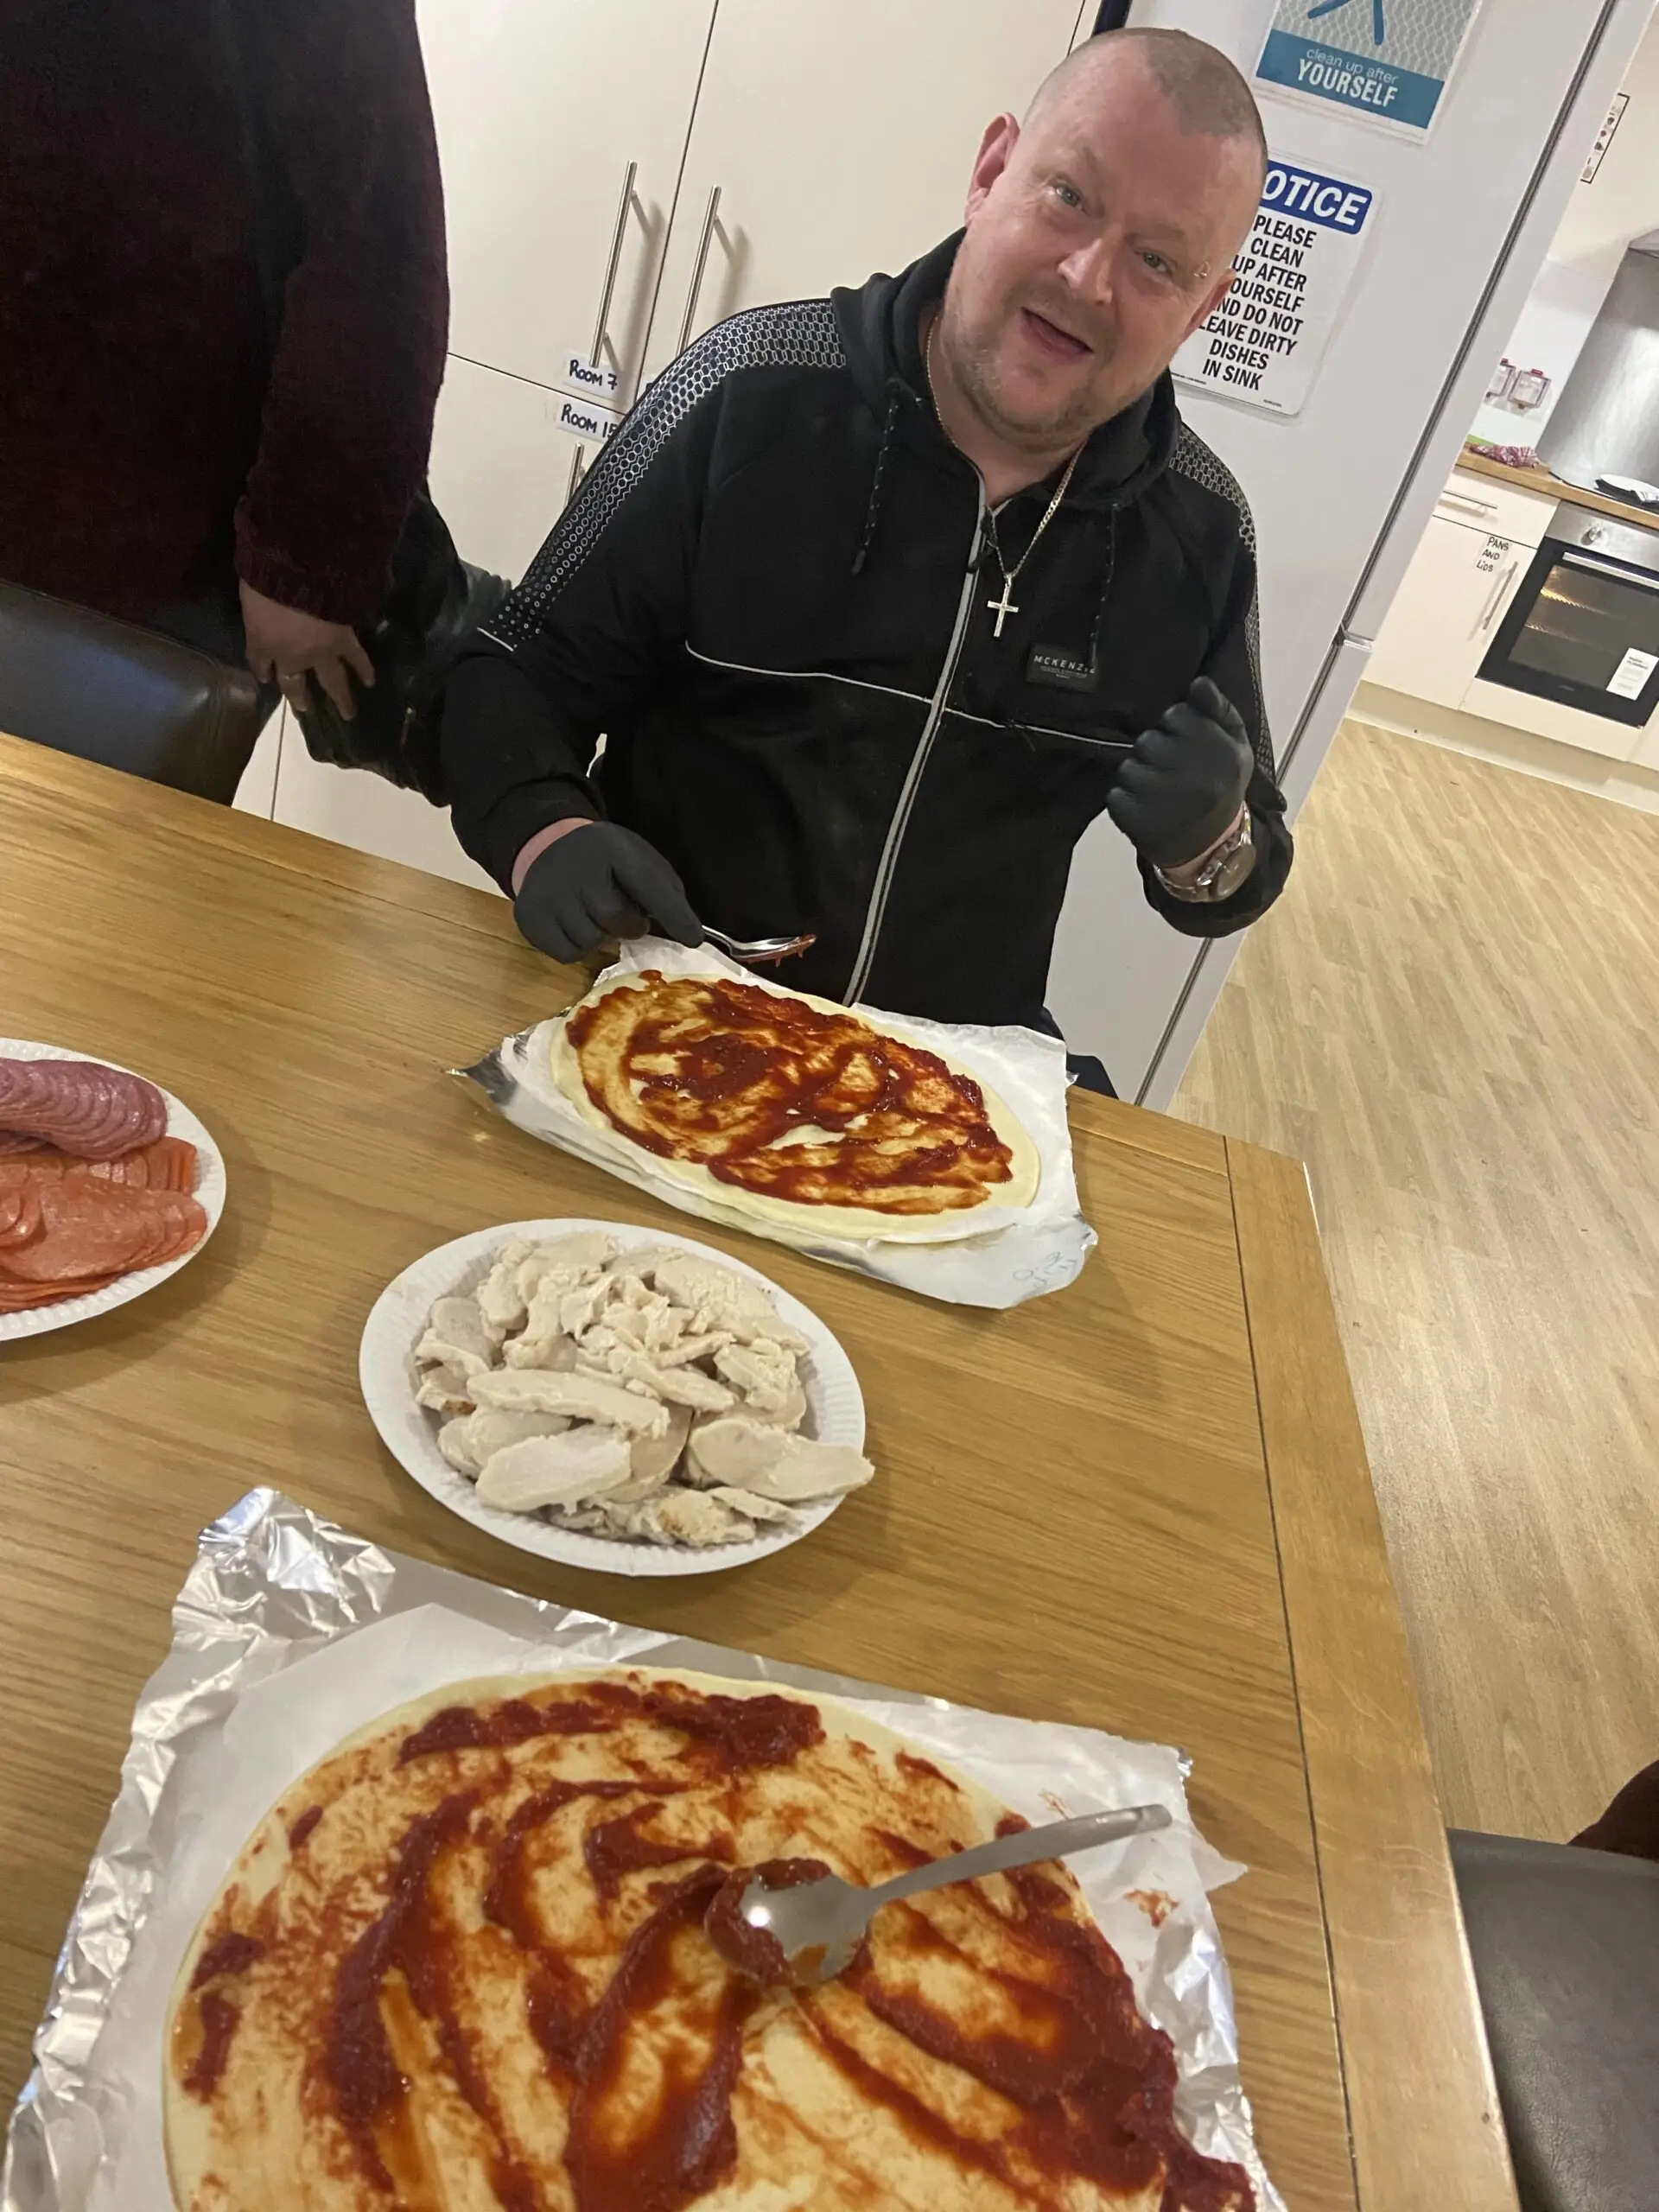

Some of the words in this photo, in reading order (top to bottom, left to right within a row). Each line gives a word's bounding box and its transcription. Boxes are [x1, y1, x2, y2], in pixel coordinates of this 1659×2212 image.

[1306, 48, 1342, 67] clean
[1345, 59, 1363, 74] up
[1366, 66, 1399, 85] after
[1298, 58, 1398, 108] YOURSELF
[1262, 169, 1368, 226] OTICE
[1253, 215, 1317, 248] PLEASE
[1250, 238, 1305, 268] CLEAN
[1231, 255, 1255, 275] UP
[1255, 263, 1307, 292] AFTER
[1230, 277, 1306, 313] OURSELF
[1243, 303, 1267, 325] DO
[1268, 312, 1304, 335] NOT
[1209, 338, 1269, 370] DISHES
[1248, 327, 1298, 356] DIRTY
[569, 359, 603, 386] ROOM
[607, 372, 618, 391] 7
[1202, 359, 1221, 378] IN
[1222, 365, 1263, 391] SINK
[561, 403, 598, 434] ROOM
[1482, 549, 1500, 560] AND
[1486, 536, 1510, 551] PANS
